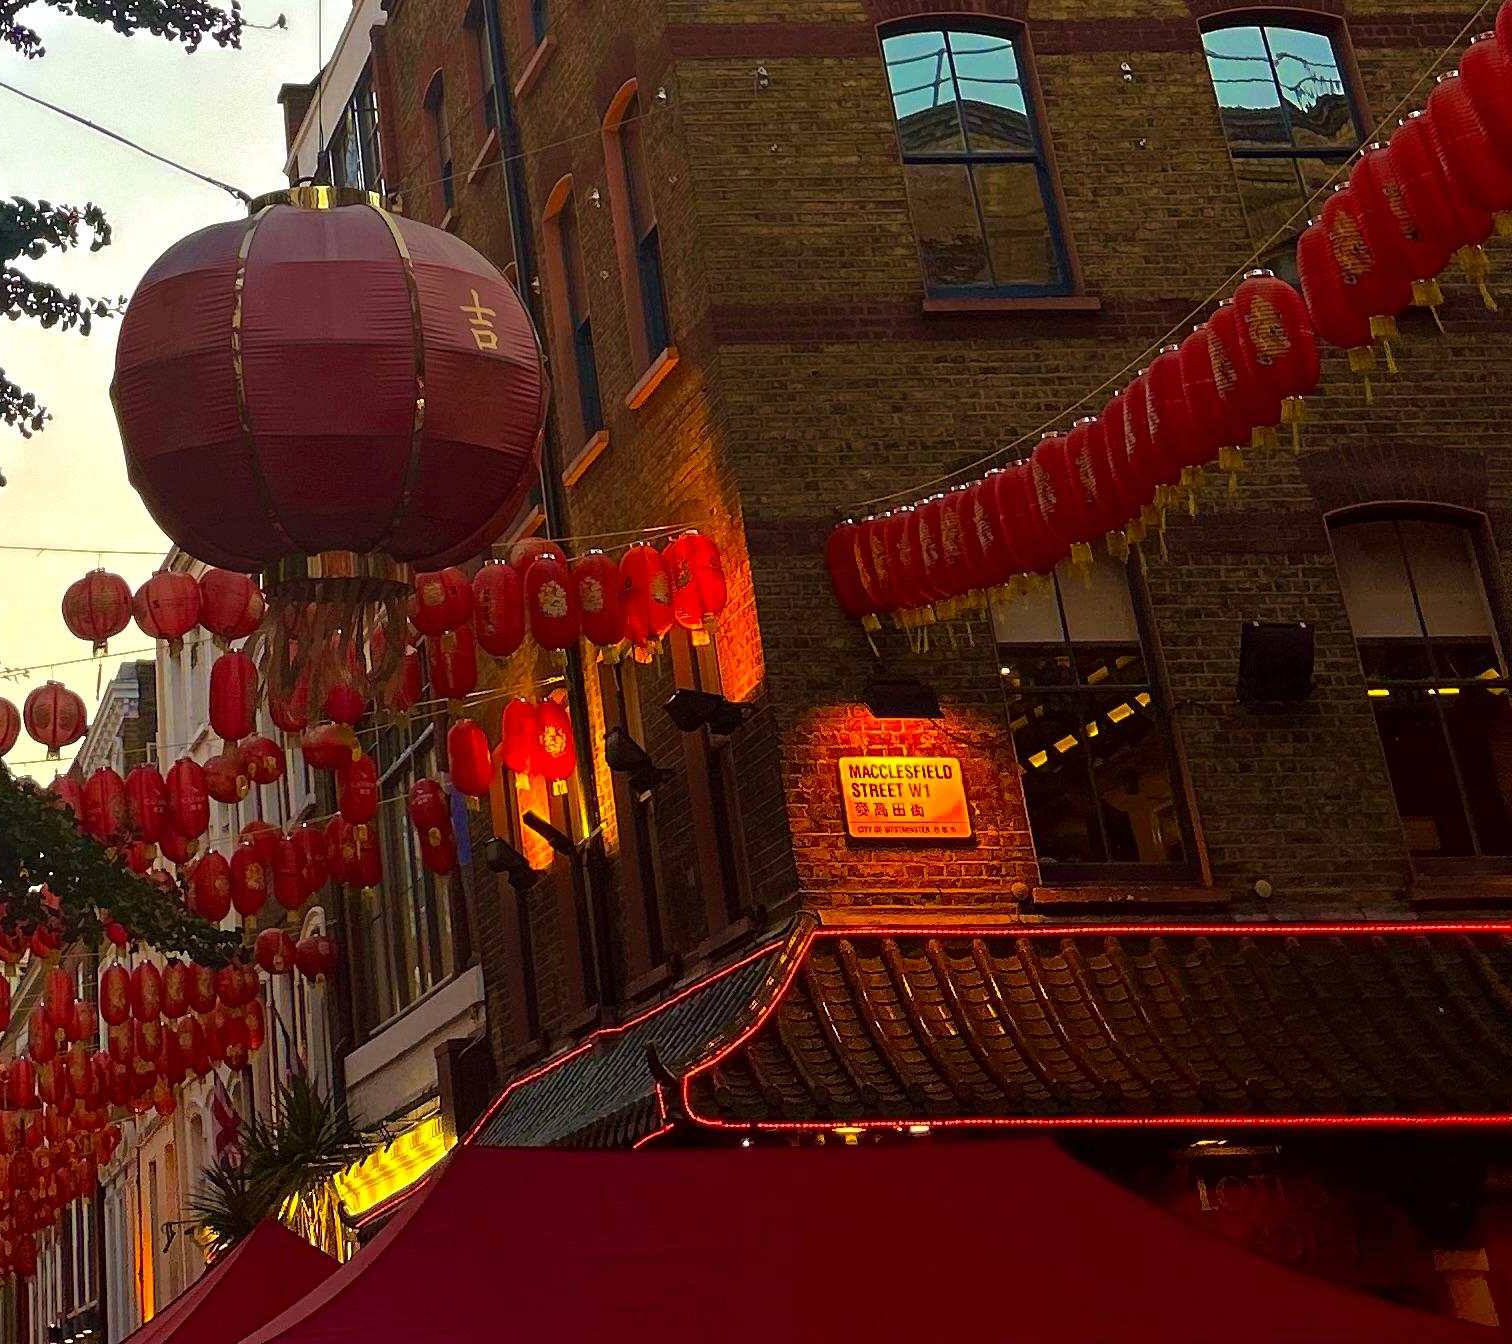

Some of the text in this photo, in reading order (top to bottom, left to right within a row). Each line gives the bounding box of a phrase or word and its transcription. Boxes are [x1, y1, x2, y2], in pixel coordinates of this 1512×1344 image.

[848, 763, 953, 779] MACCLESFIELD
[851, 782, 931, 798] STREET W1
